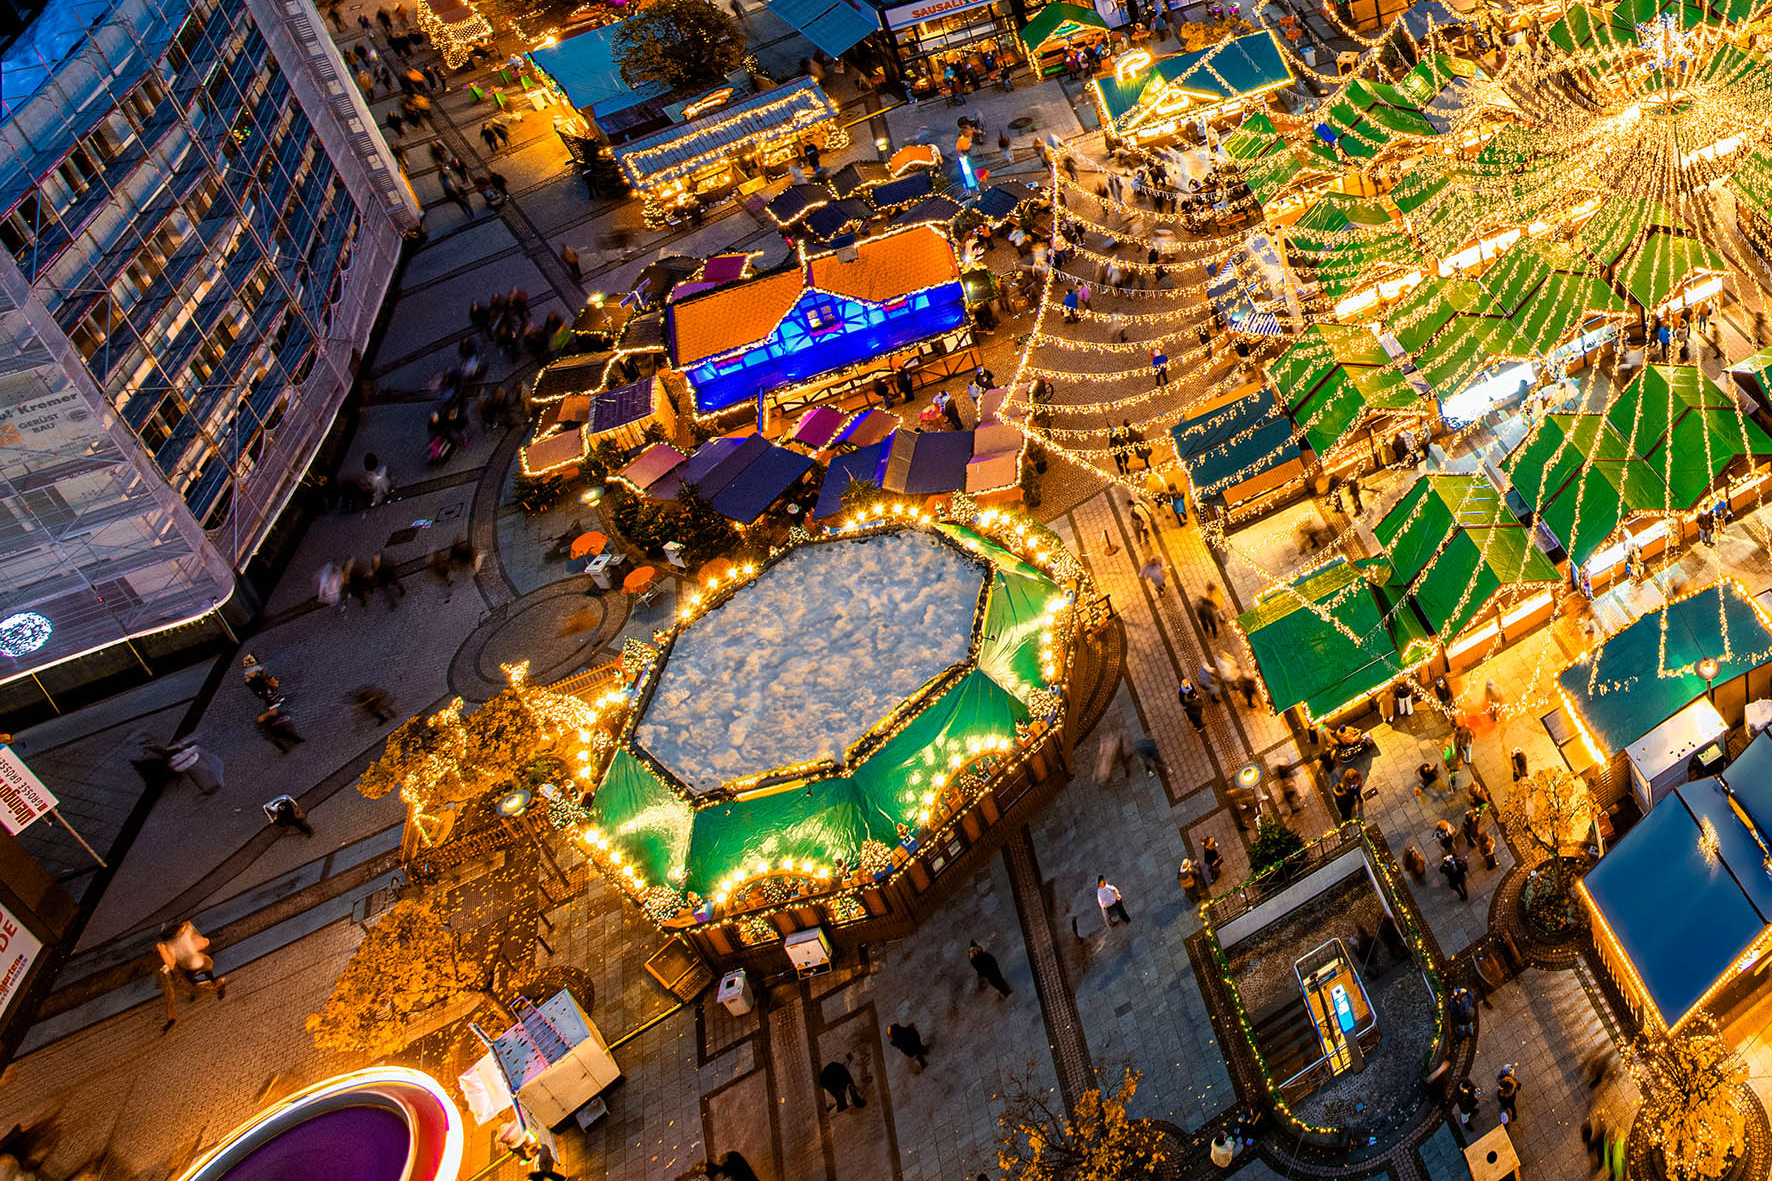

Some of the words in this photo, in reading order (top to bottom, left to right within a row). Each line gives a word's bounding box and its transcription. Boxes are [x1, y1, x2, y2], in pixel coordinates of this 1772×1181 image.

[18, 393, 77, 415] Kremer
[19, 413, 58, 429] GERÜST
[32, 423, 55, 433] BAU
